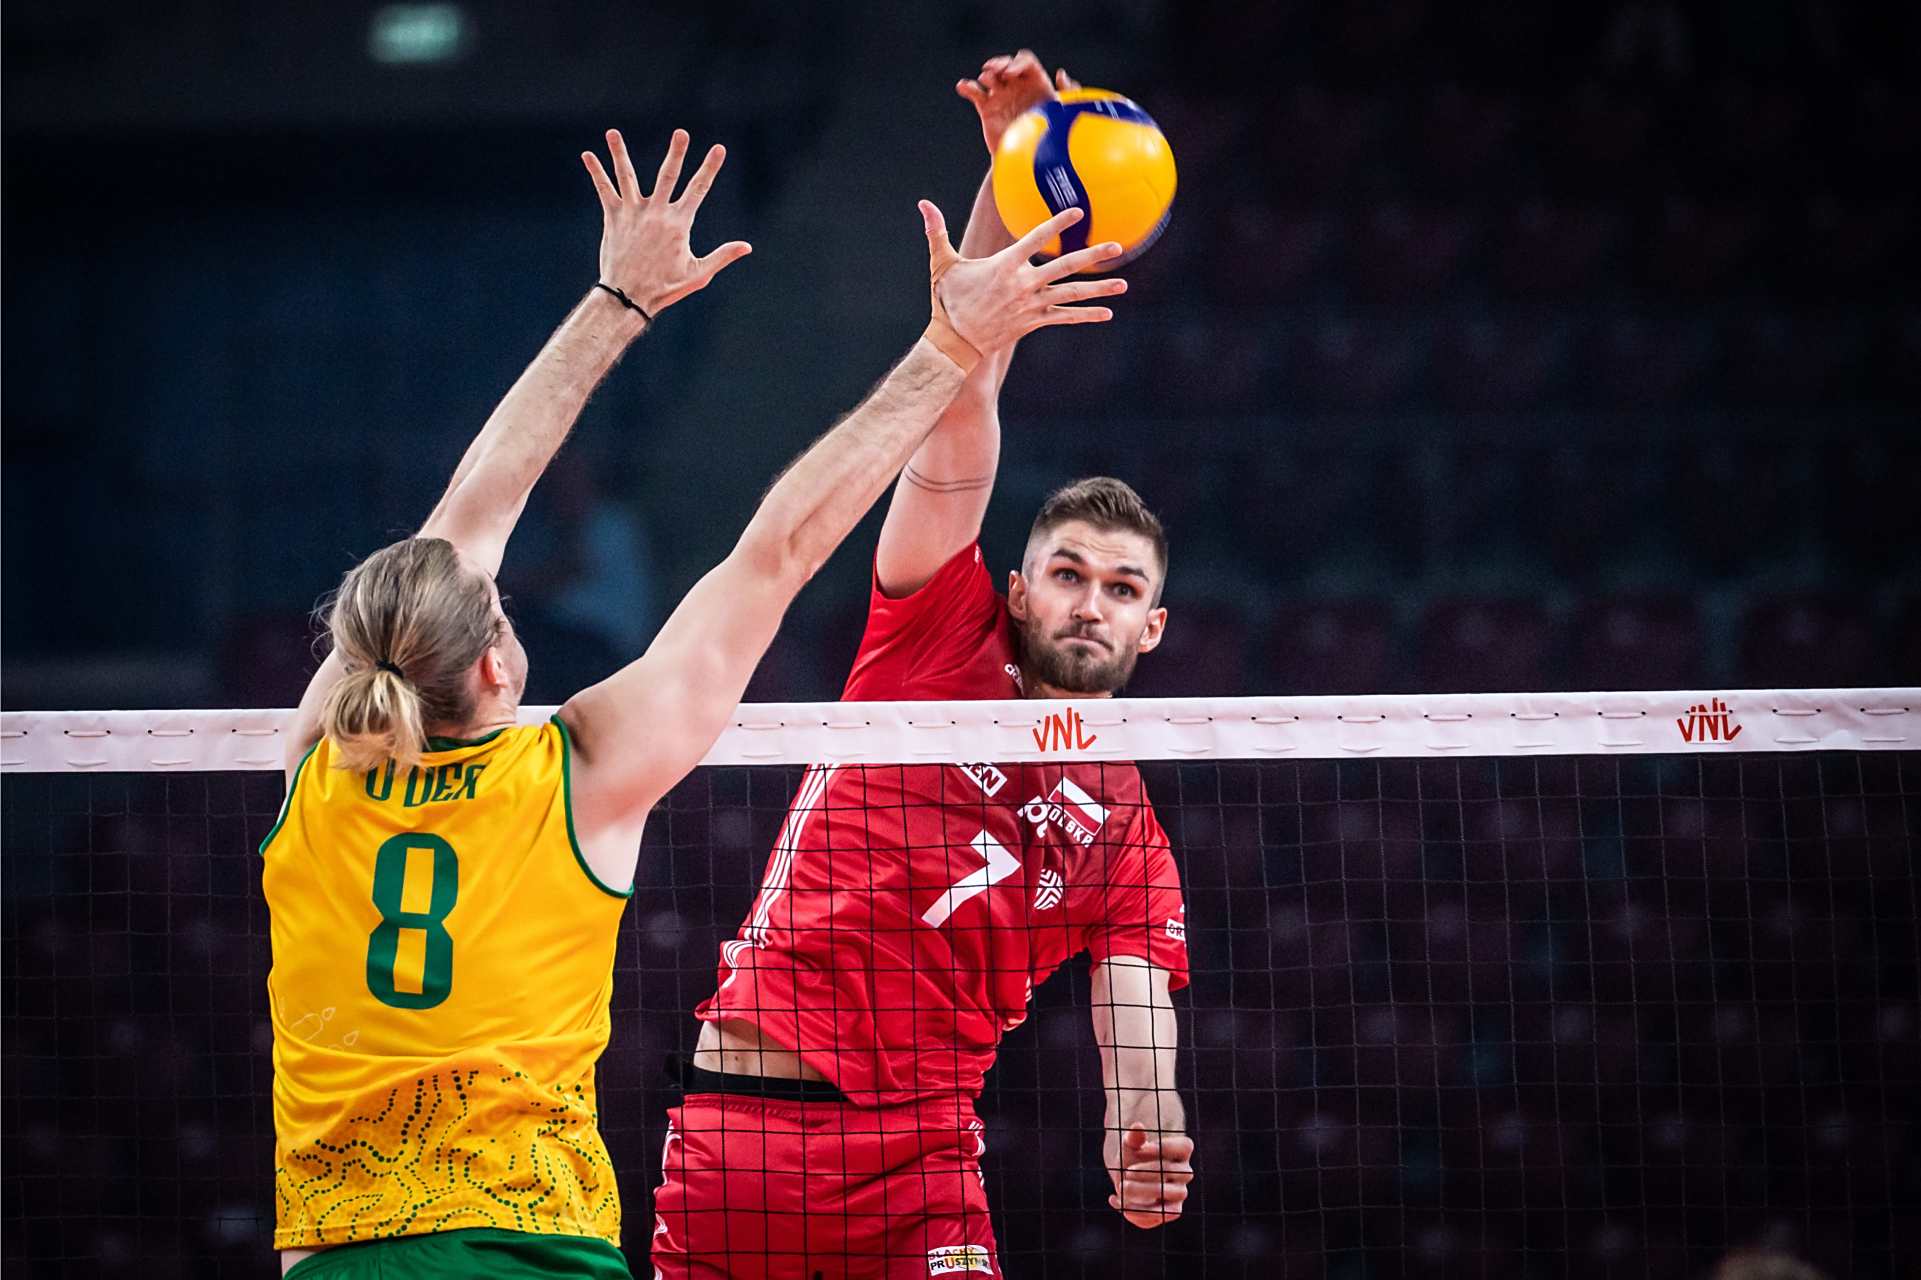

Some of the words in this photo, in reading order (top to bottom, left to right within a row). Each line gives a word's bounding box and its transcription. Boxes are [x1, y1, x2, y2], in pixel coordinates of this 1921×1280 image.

[1032, 707, 1097, 752] VNL
[1677, 696, 1742, 742] VNL
[921, 829, 1022, 929] 7
[366, 832, 459, 1010] 8
